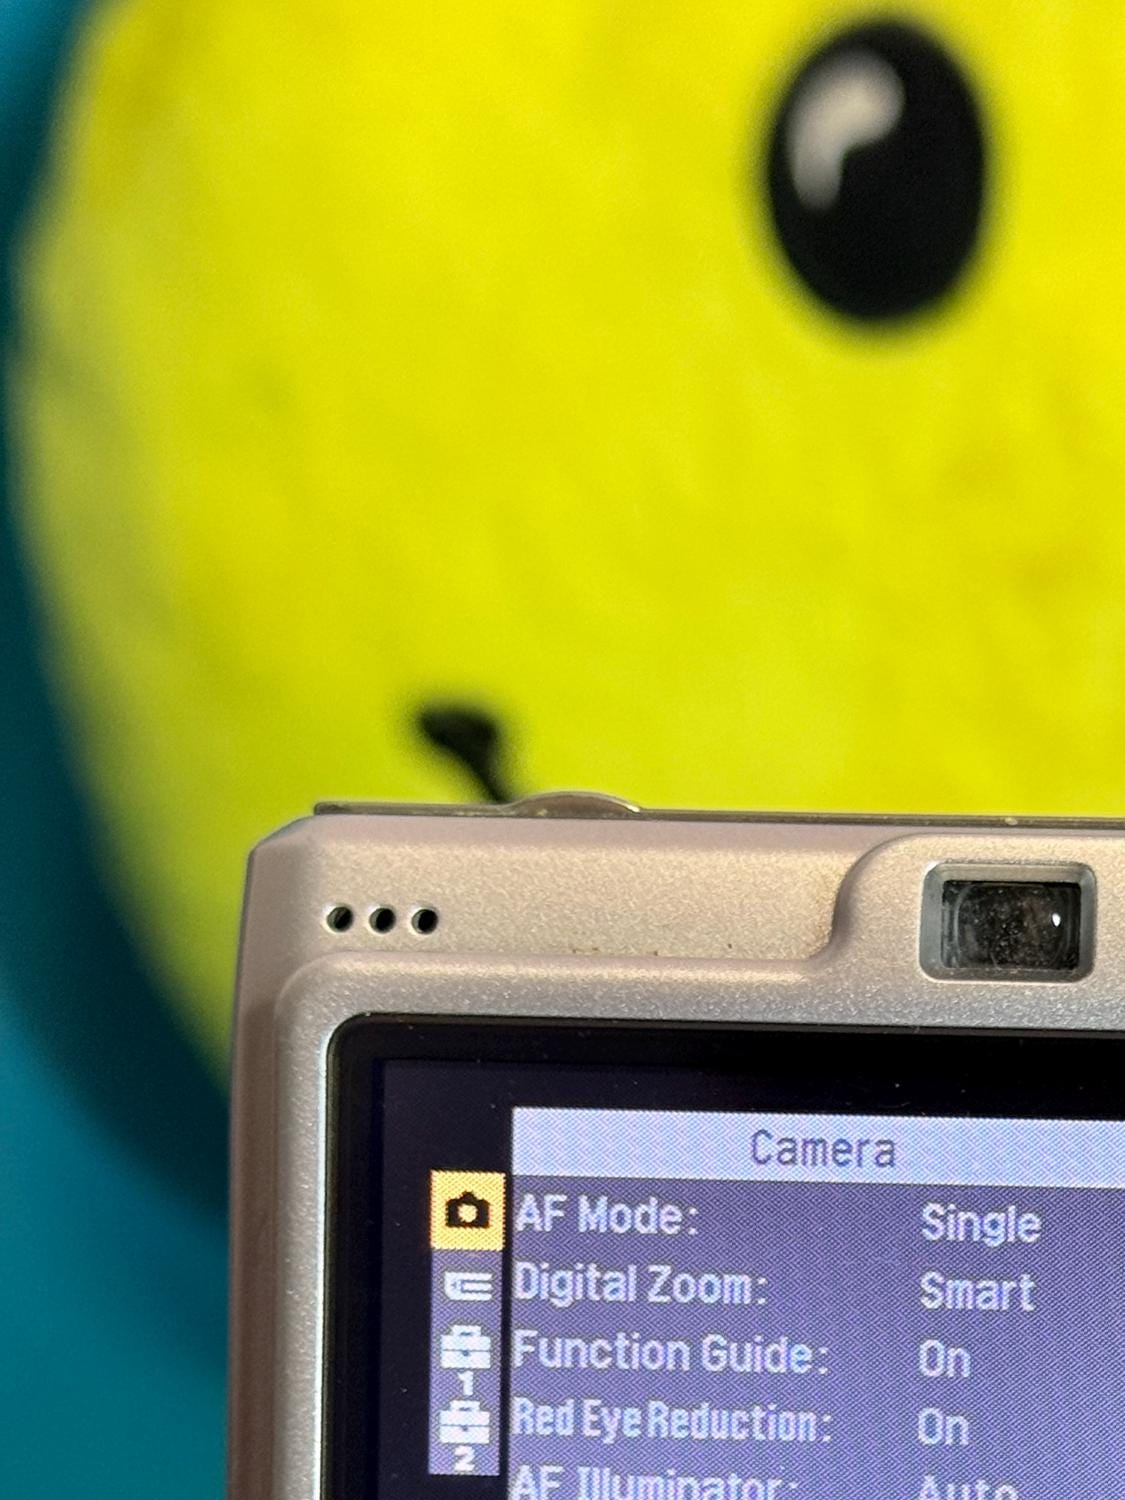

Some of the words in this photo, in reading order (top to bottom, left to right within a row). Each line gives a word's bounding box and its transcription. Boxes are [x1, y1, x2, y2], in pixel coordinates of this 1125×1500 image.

[750, 1129, 896, 1168] Camera
[515, 1193, 567, 1232] AF
[577, 1195, 699, 1235] Mode:
[921, 1202, 1042, 1247] Single
[513, 1261, 637, 1308] Digital
[648, 1264, 767, 1305] Zoom:
[919, 1270, 1036, 1312] Smart
[512, 1329, 690, 1371] Function
[702, 1333, 829, 1375] Guide:
[918, 1339, 971, 1378] On
[456, 1371, 475, 1396] 1
[512, 1397, 574, 1436] Red
[583, 1399, 642, 1444] Eye
[648, 1400, 832, 1443] Reduction:
[917, 1407, 969, 1445] On
[453, 1445, 475, 1472] 2
